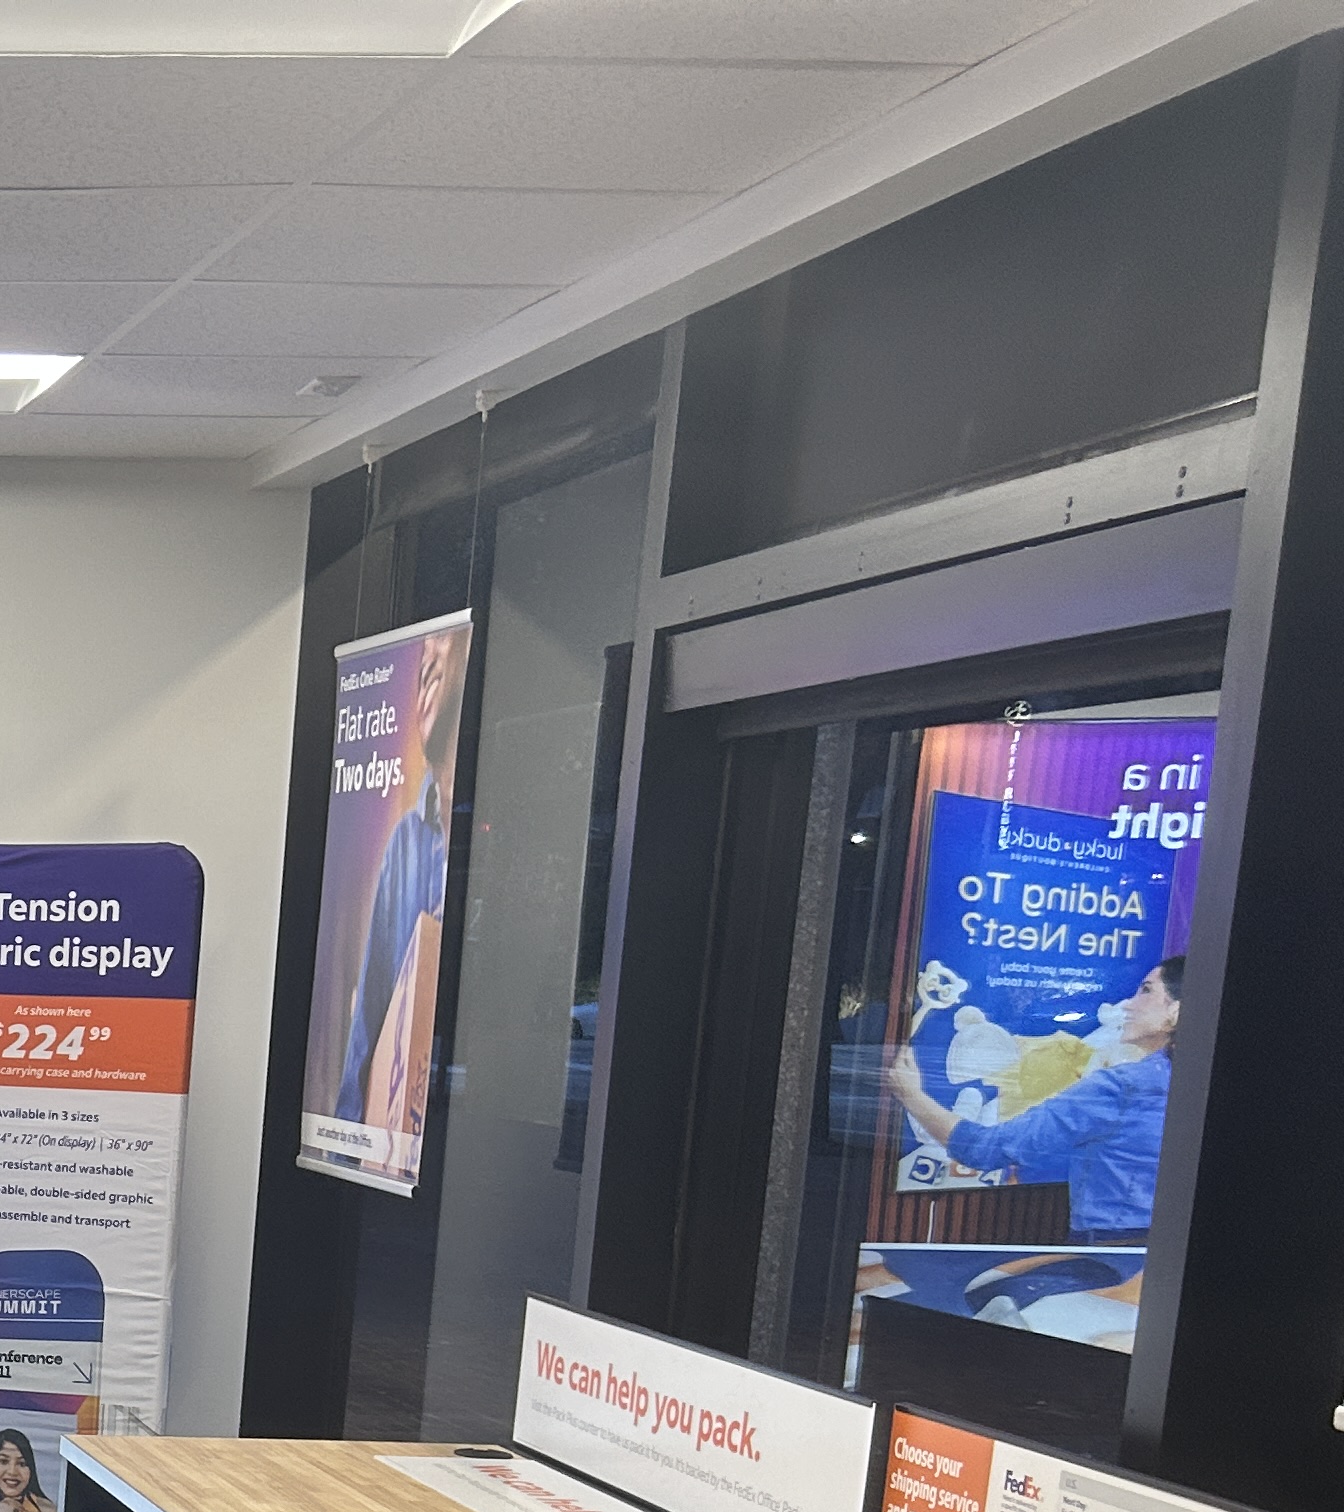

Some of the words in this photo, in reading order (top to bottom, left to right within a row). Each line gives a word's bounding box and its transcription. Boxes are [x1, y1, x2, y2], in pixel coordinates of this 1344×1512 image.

[337, 706, 364, 744] Flat
[365, 700, 398, 738] rate.
[335, 759, 363, 793] Two
[366, 751, 404, 798] days.
[48, 937, 175, 978] display
[14, 1005, 29, 1015] As
[30, 1006, 63, 1017] shown
[66, 1007, 91, 1017] here
[0, 1066, 44, 1078] carrying
[46, 1068, 69, 1078] case
[72, 1068, 93, 1078] and
[94, 1068, 146, 1080] hardware
[48, 1110, 58, 1120] in
[61, 1111, 68, 1121] 3
[71, 1111, 99, 1123] sizes
[55, 1162, 76, 1173] and
[79, 1164, 134, 1177] washable
[30, 1186, 106, 1201] double-sided
[109, 1192, 154, 1205] graphic
[50, 1214, 72, 1224] and
[74, 1214, 131, 1229] transport
[537, 1339, 564, 1385] We
[568, 1360, 602, 1400] can
[605, 1363, 648, 1427] help
[651, 1391, 694, 1435] you
[696, 1409, 760, 1462] pack.
[894, 1437, 935, 1469] Choose
[935, 1454, 963, 1478] your
[890, 1468, 937, 1509] shipping
[1004, 1470, 1041, 1501] FedEx
